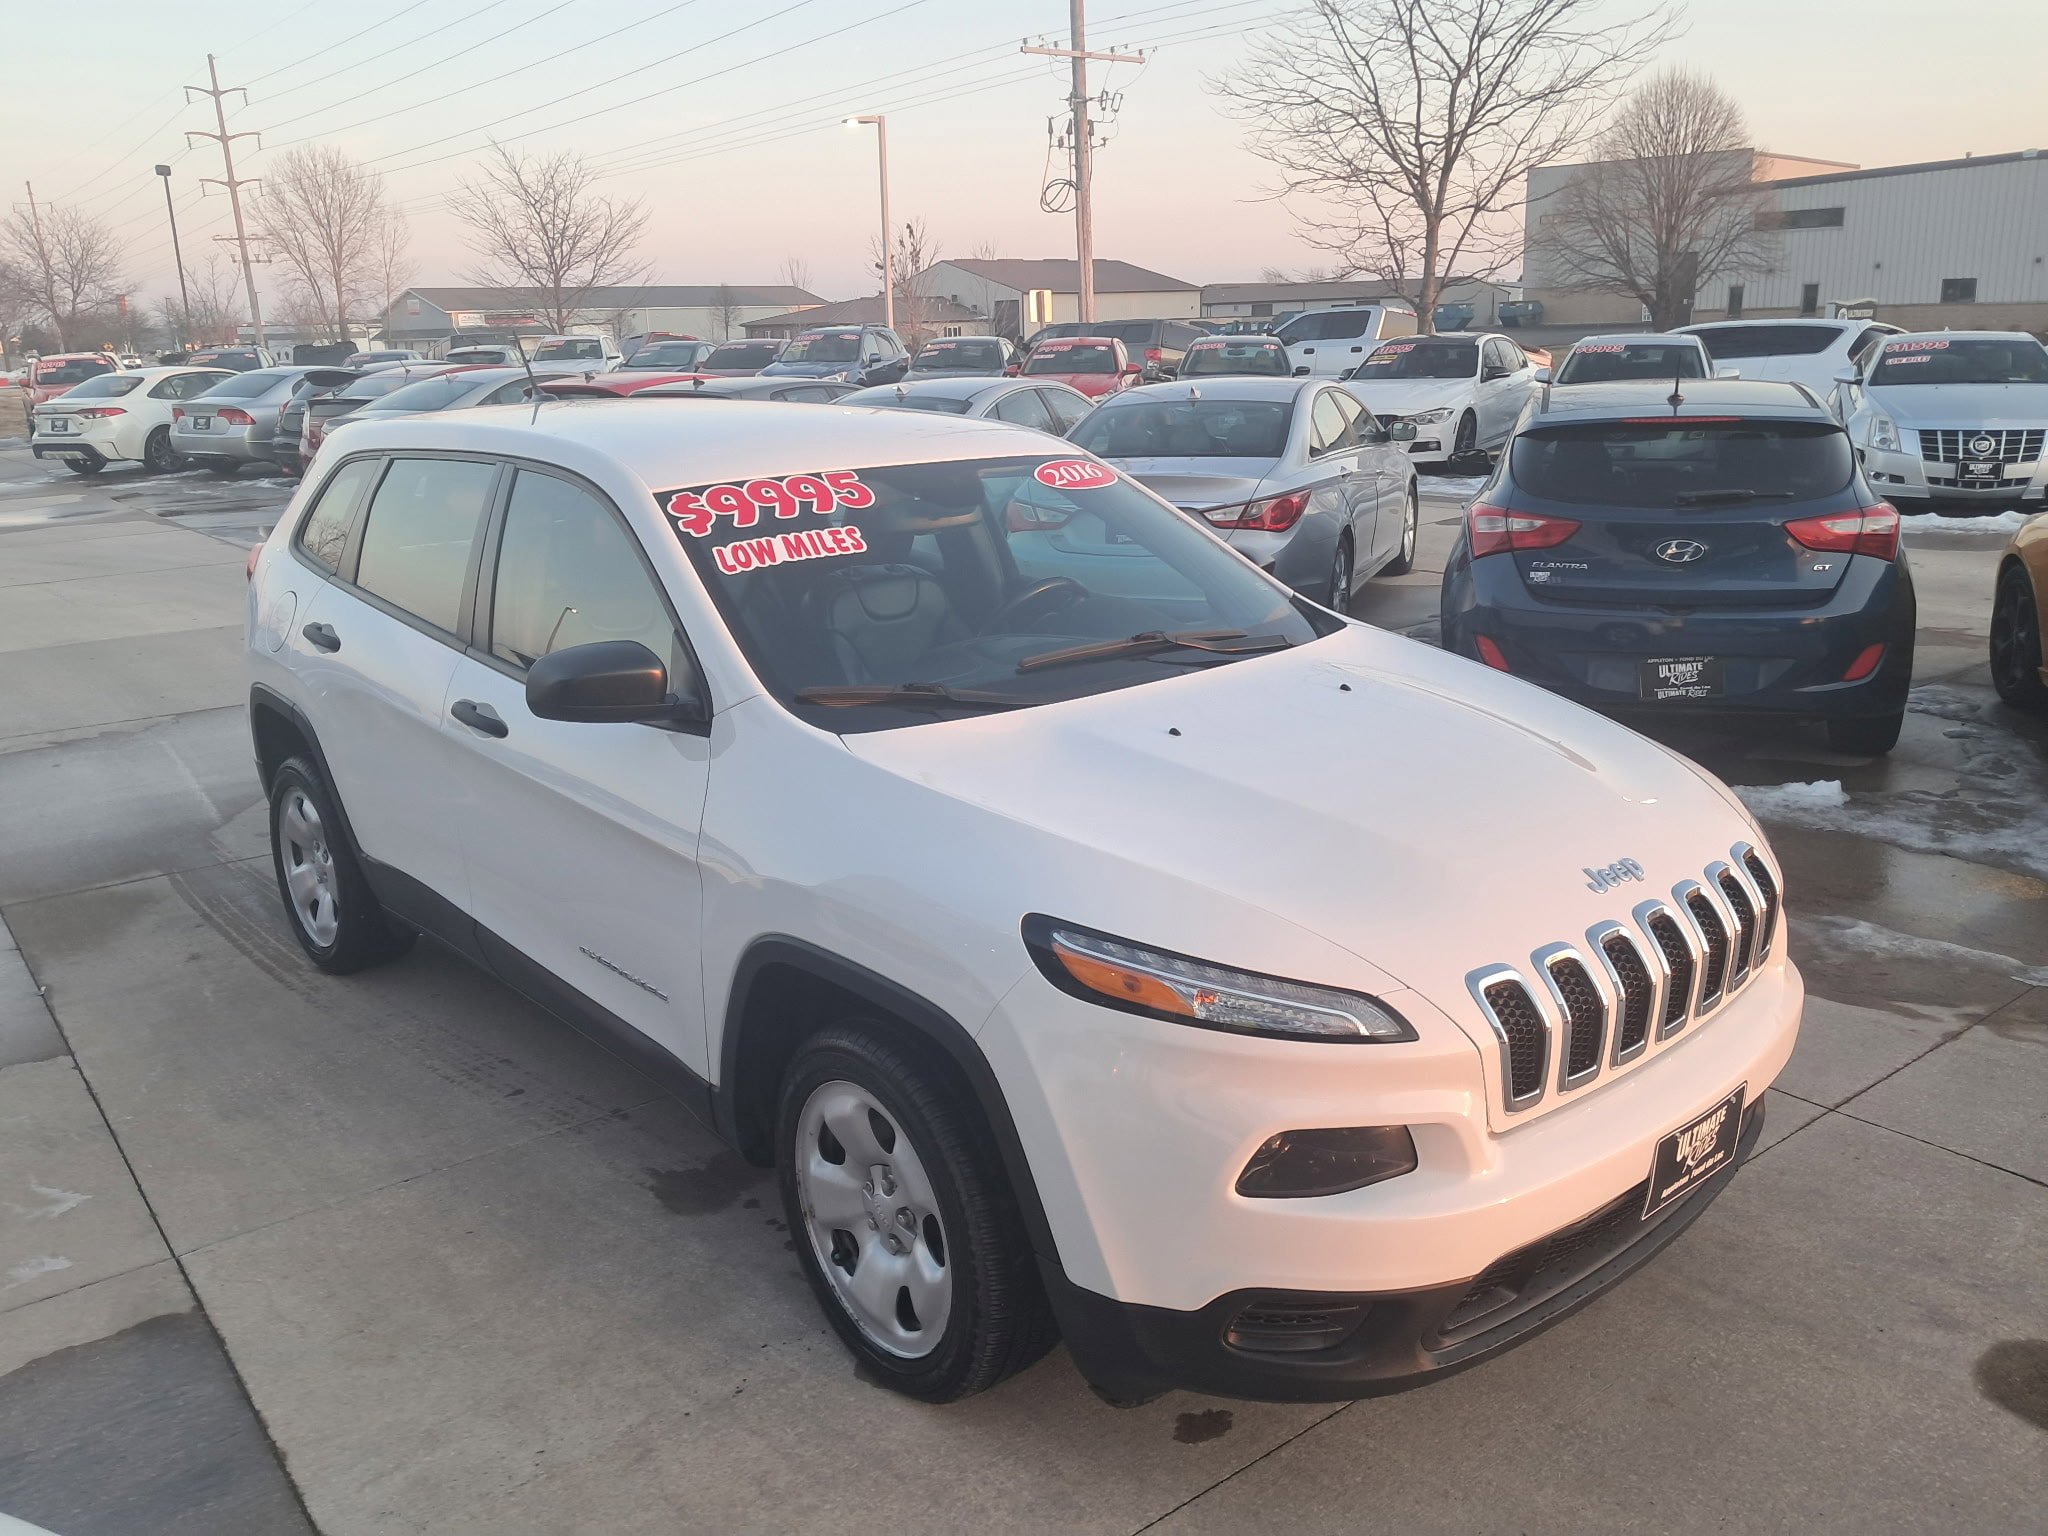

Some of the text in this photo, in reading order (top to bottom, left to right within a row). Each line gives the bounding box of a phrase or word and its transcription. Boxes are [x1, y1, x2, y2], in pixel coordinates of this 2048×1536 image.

[1905, 355, 1931, 363] MILES
[1043, 463, 1103, 485] 2016
[668, 471, 875, 537] $9995
[714, 527, 864, 573] LOW MILES
[1531, 561, 1588, 569] ELANTRA
[1659, 662, 1703, 678] ULTIMATE
[1582, 857, 1645, 895] Jeep
[1676, 1104, 1728, 1163] ULTIMATE
